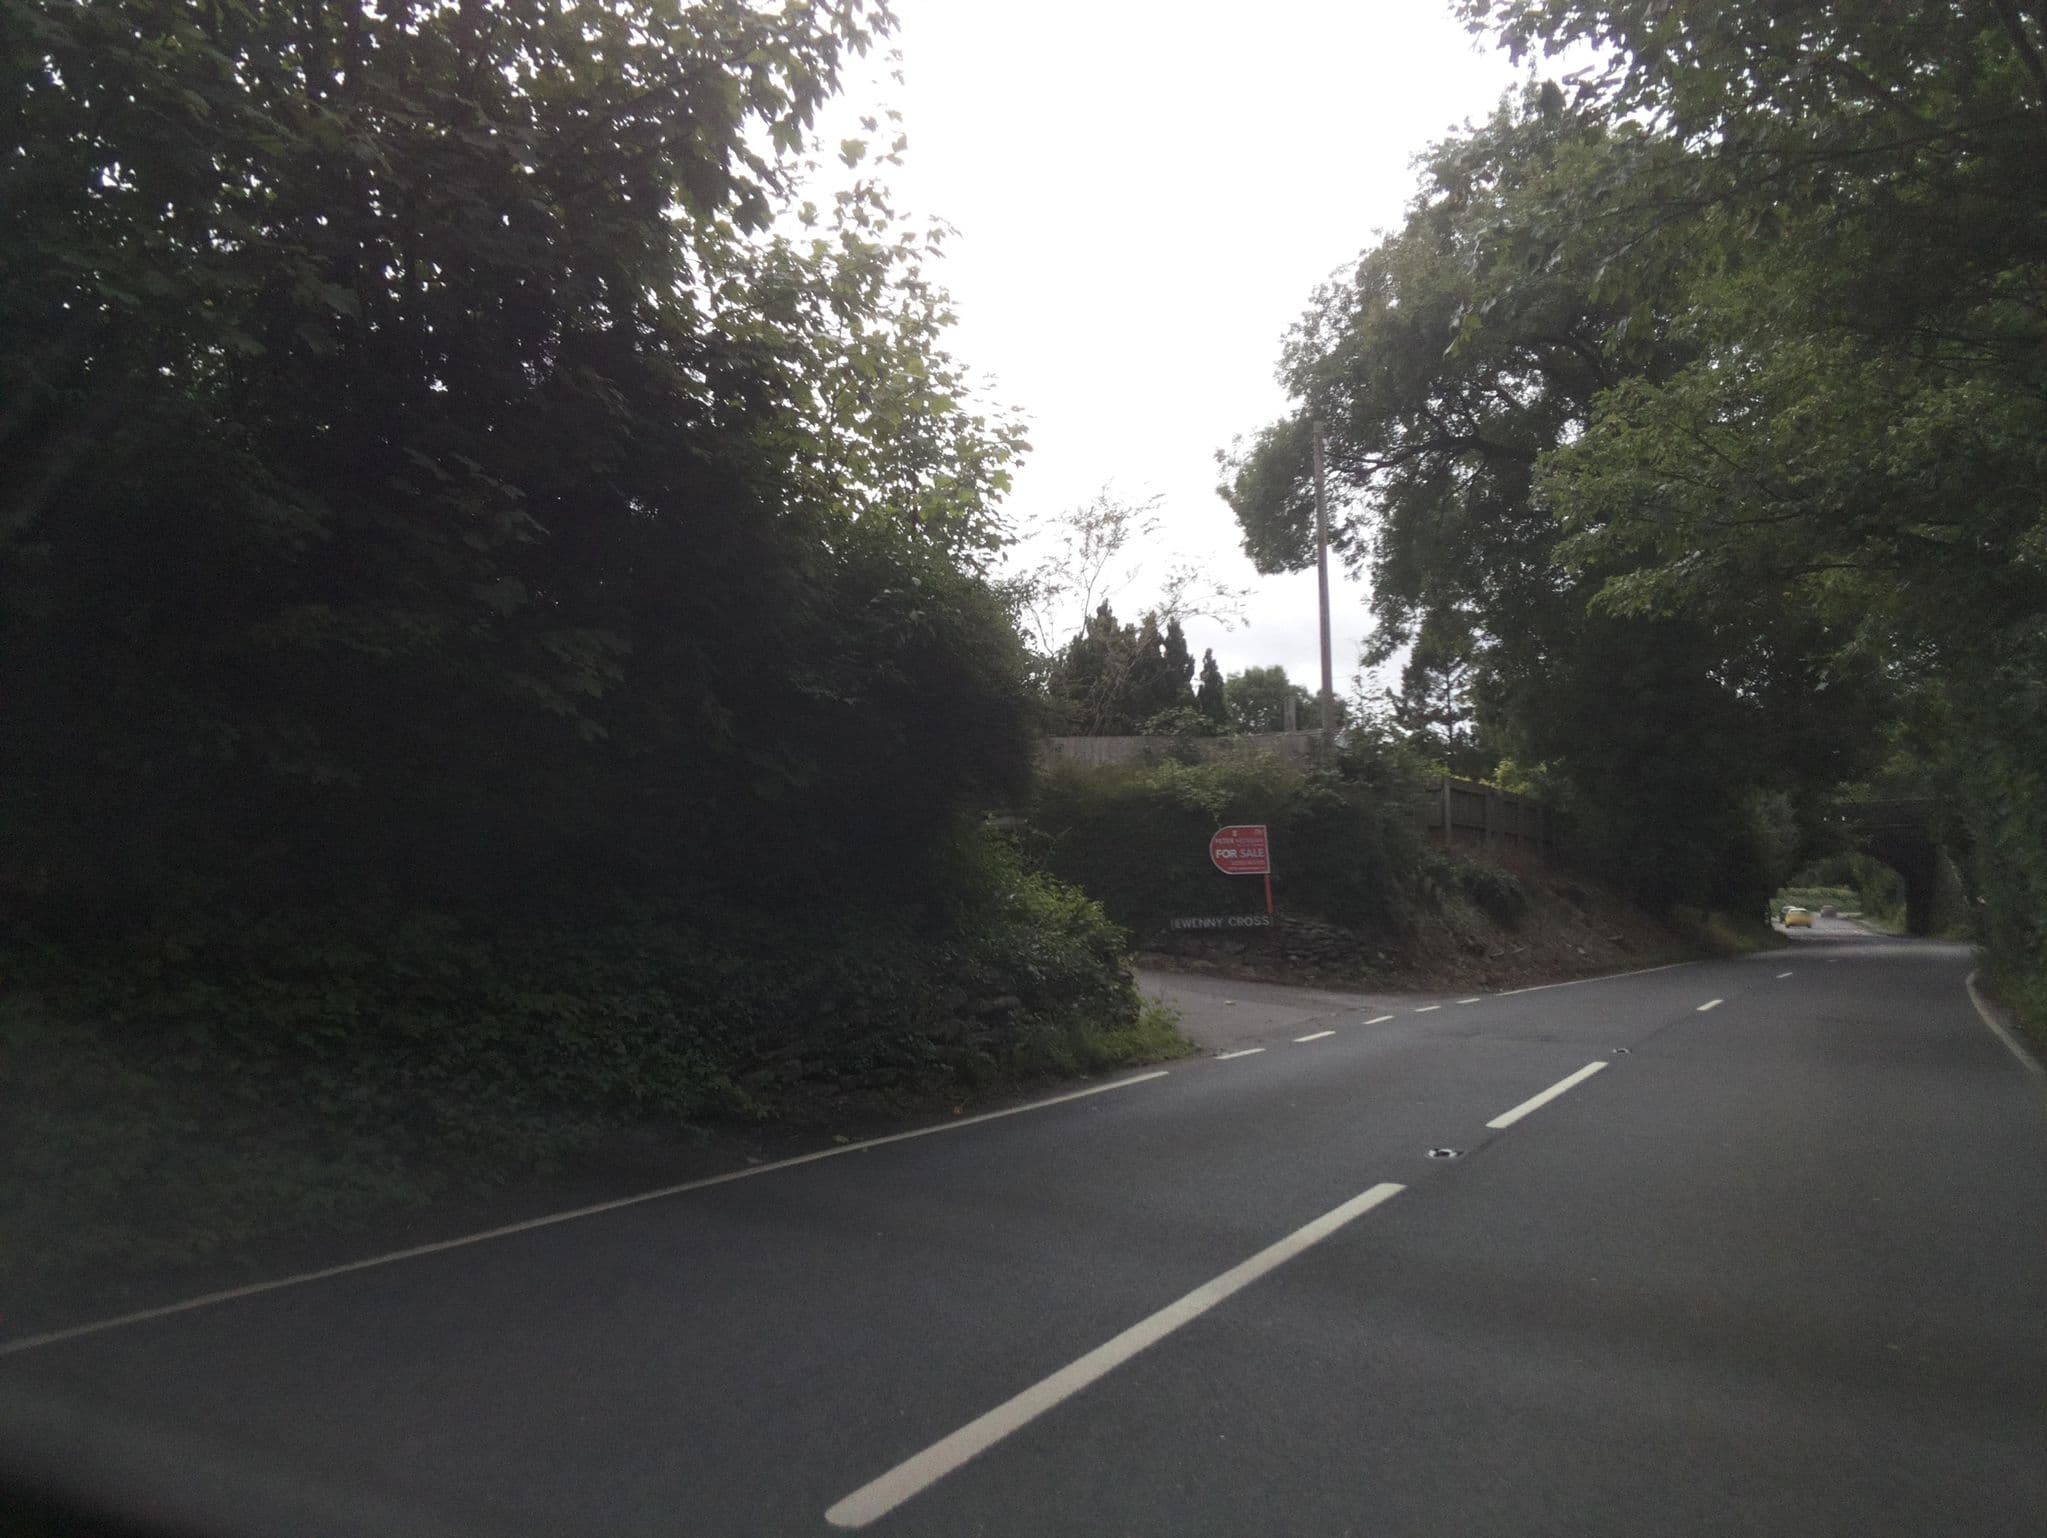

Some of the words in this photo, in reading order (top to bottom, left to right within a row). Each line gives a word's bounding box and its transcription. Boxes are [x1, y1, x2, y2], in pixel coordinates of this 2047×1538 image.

[1215, 849, 1238, 859] FOR
[1239, 848, 1265, 858] SALE
[1228, 915, 1270, 928] CROSS
